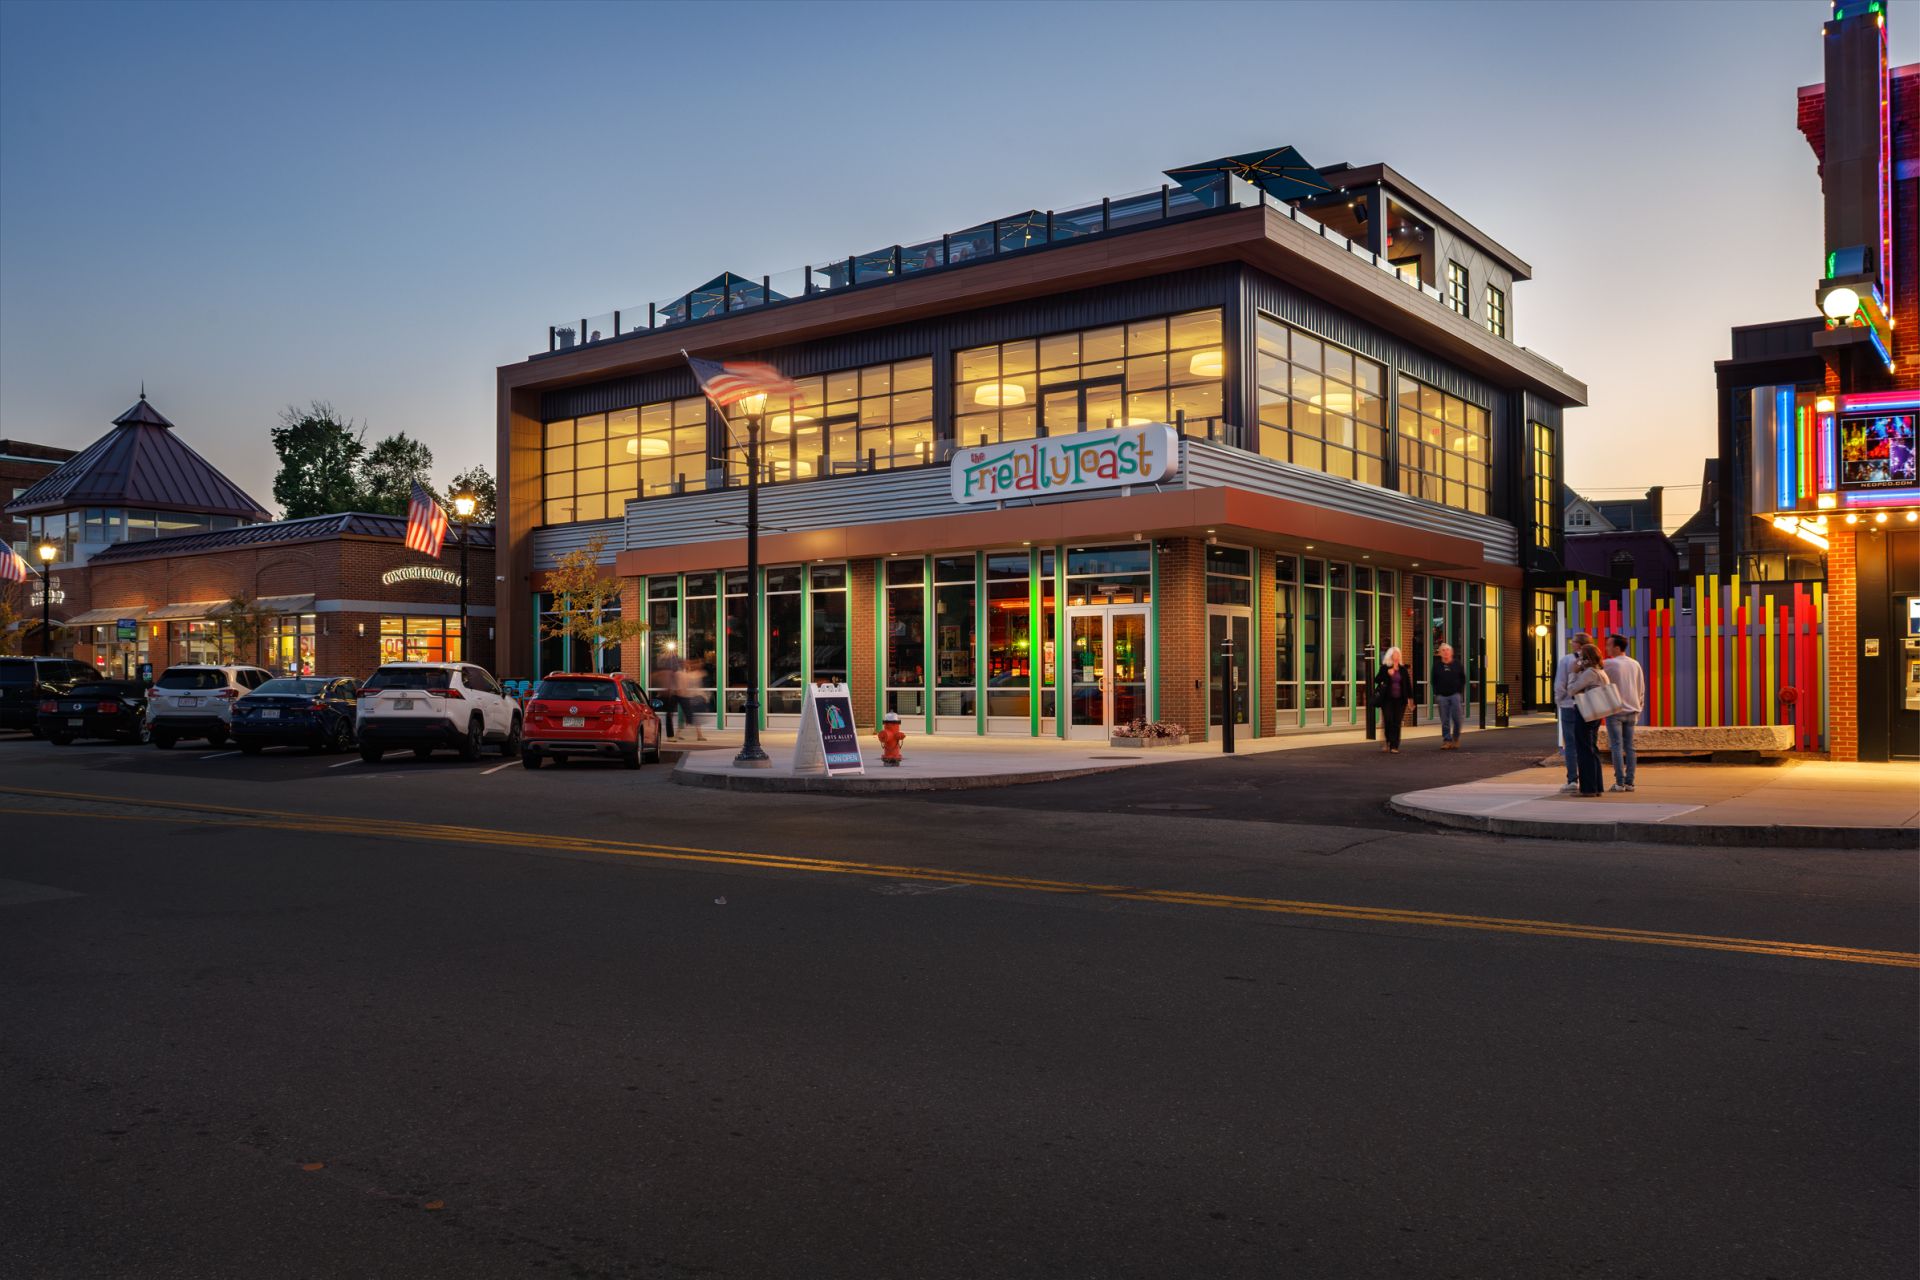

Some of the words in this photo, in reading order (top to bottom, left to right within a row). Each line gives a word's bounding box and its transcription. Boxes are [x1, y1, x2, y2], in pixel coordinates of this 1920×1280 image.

[963, 443, 1071, 497] Friendly
[1060, 431, 1154, 485] Toast
[970, 452, 986, 464] the
[382, 567, 420, 585] CONCORD
[421, 567, 444, 581] FOOD
[827, 754, 842, 763] NOW
[842, 753, 858, 762] OPEN
